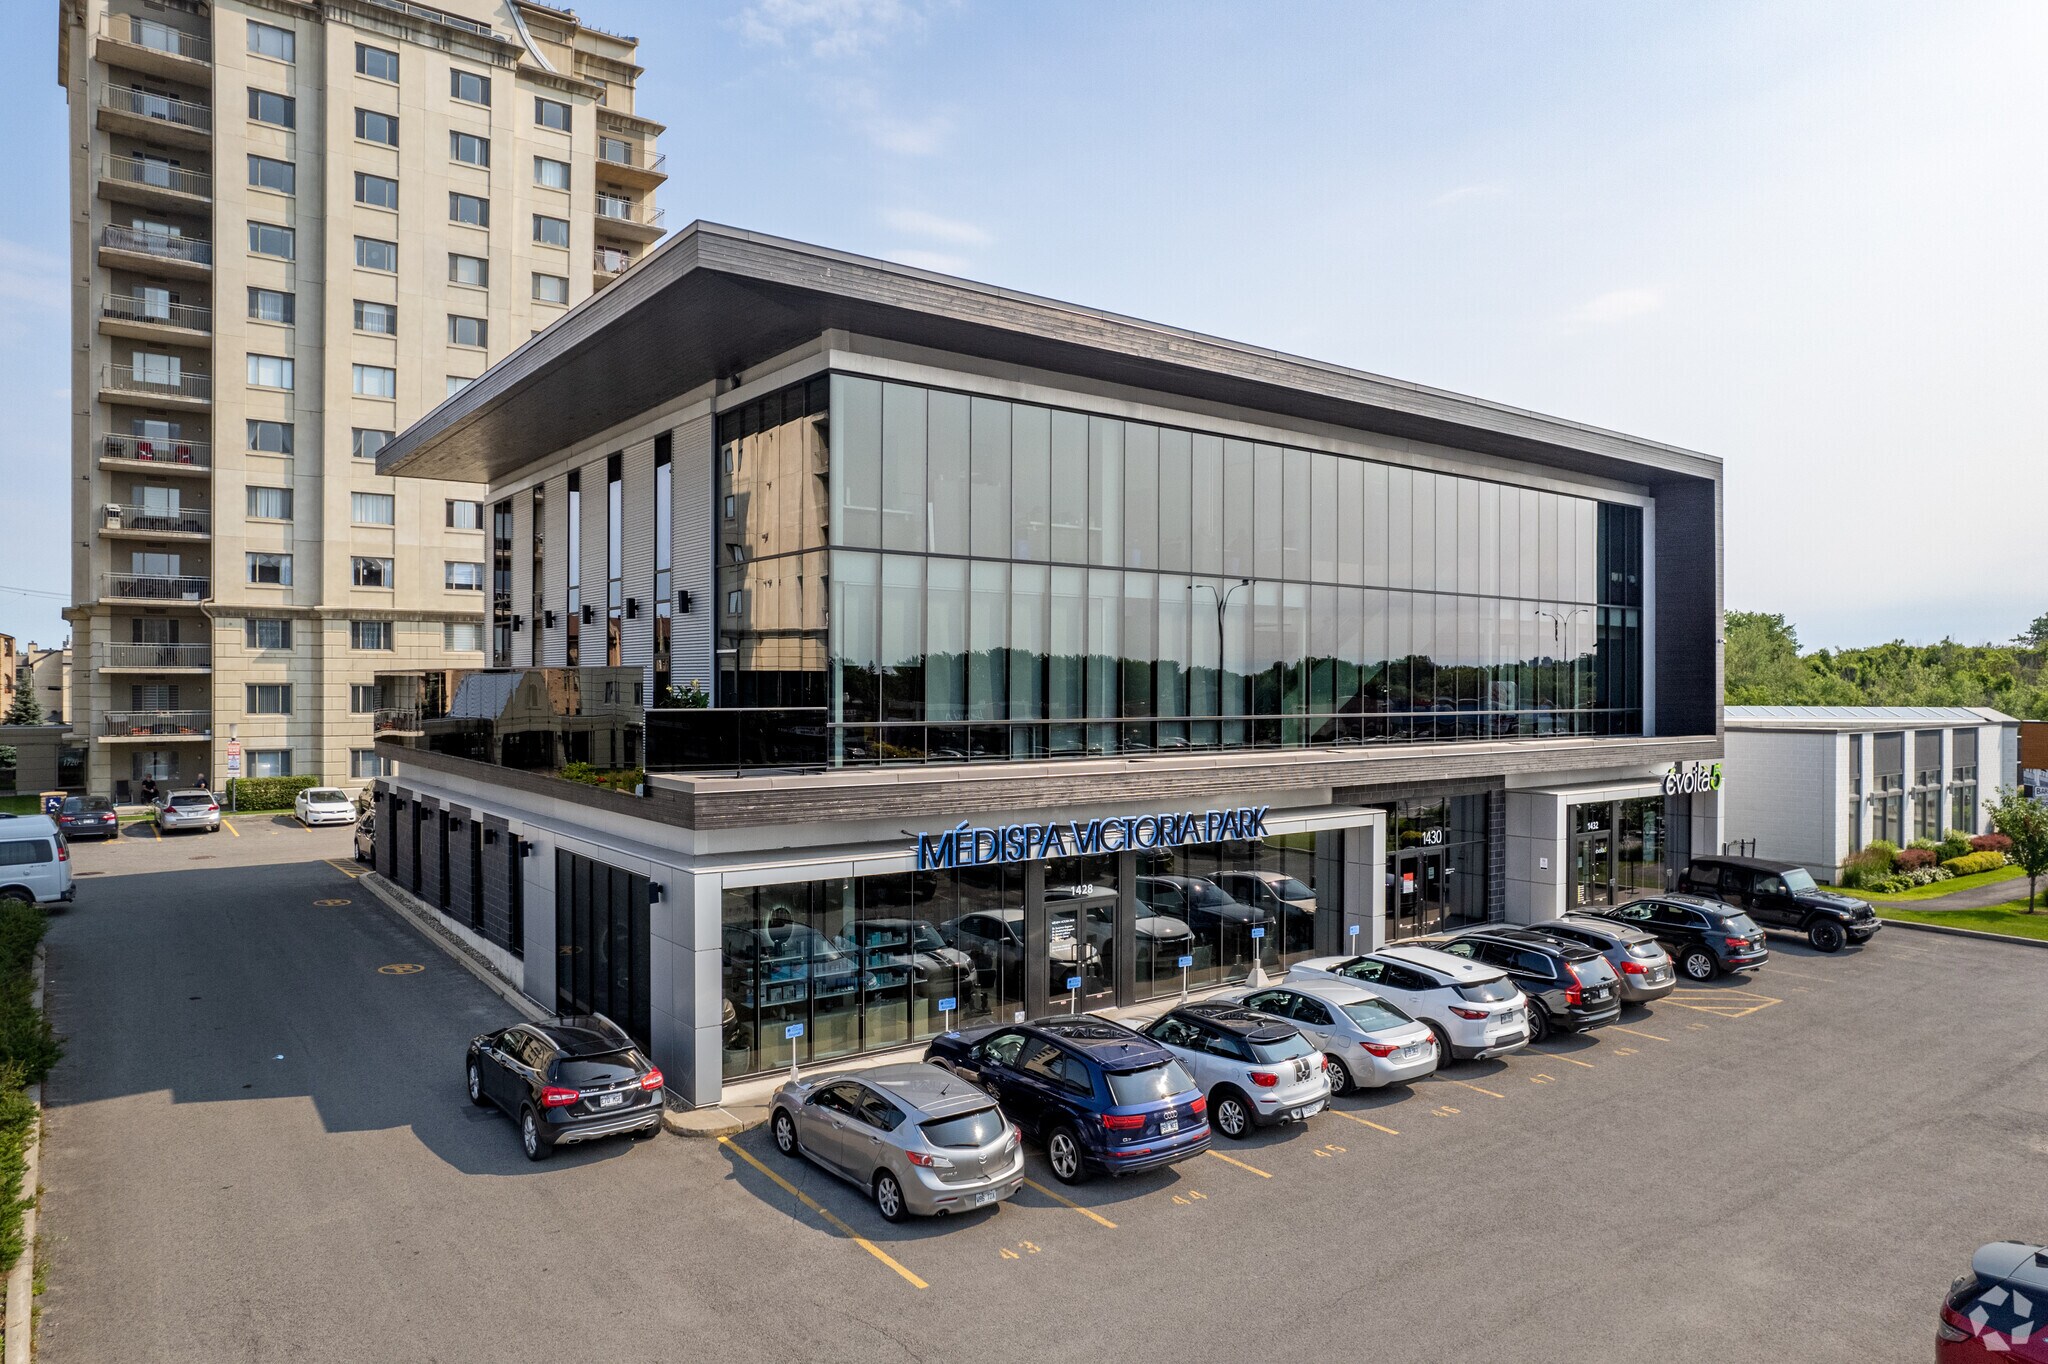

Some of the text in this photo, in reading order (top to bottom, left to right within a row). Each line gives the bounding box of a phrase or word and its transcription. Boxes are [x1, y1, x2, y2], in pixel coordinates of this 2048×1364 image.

[1587, 821, 1599, 830] 1432
[918, 805, 1270, 870] MÉDISPA VICTORIA PARK
[1421, 829, 1442, 844] 1430
[1070, 884, 1094, 896] 1428
[1431, 1105, 1461, 1118] 46
[1312, 1144, 1348, 1158] 45
[1171, 1190, 1208, 1205] 44
[999, 1240, 1041, 1259] 43
